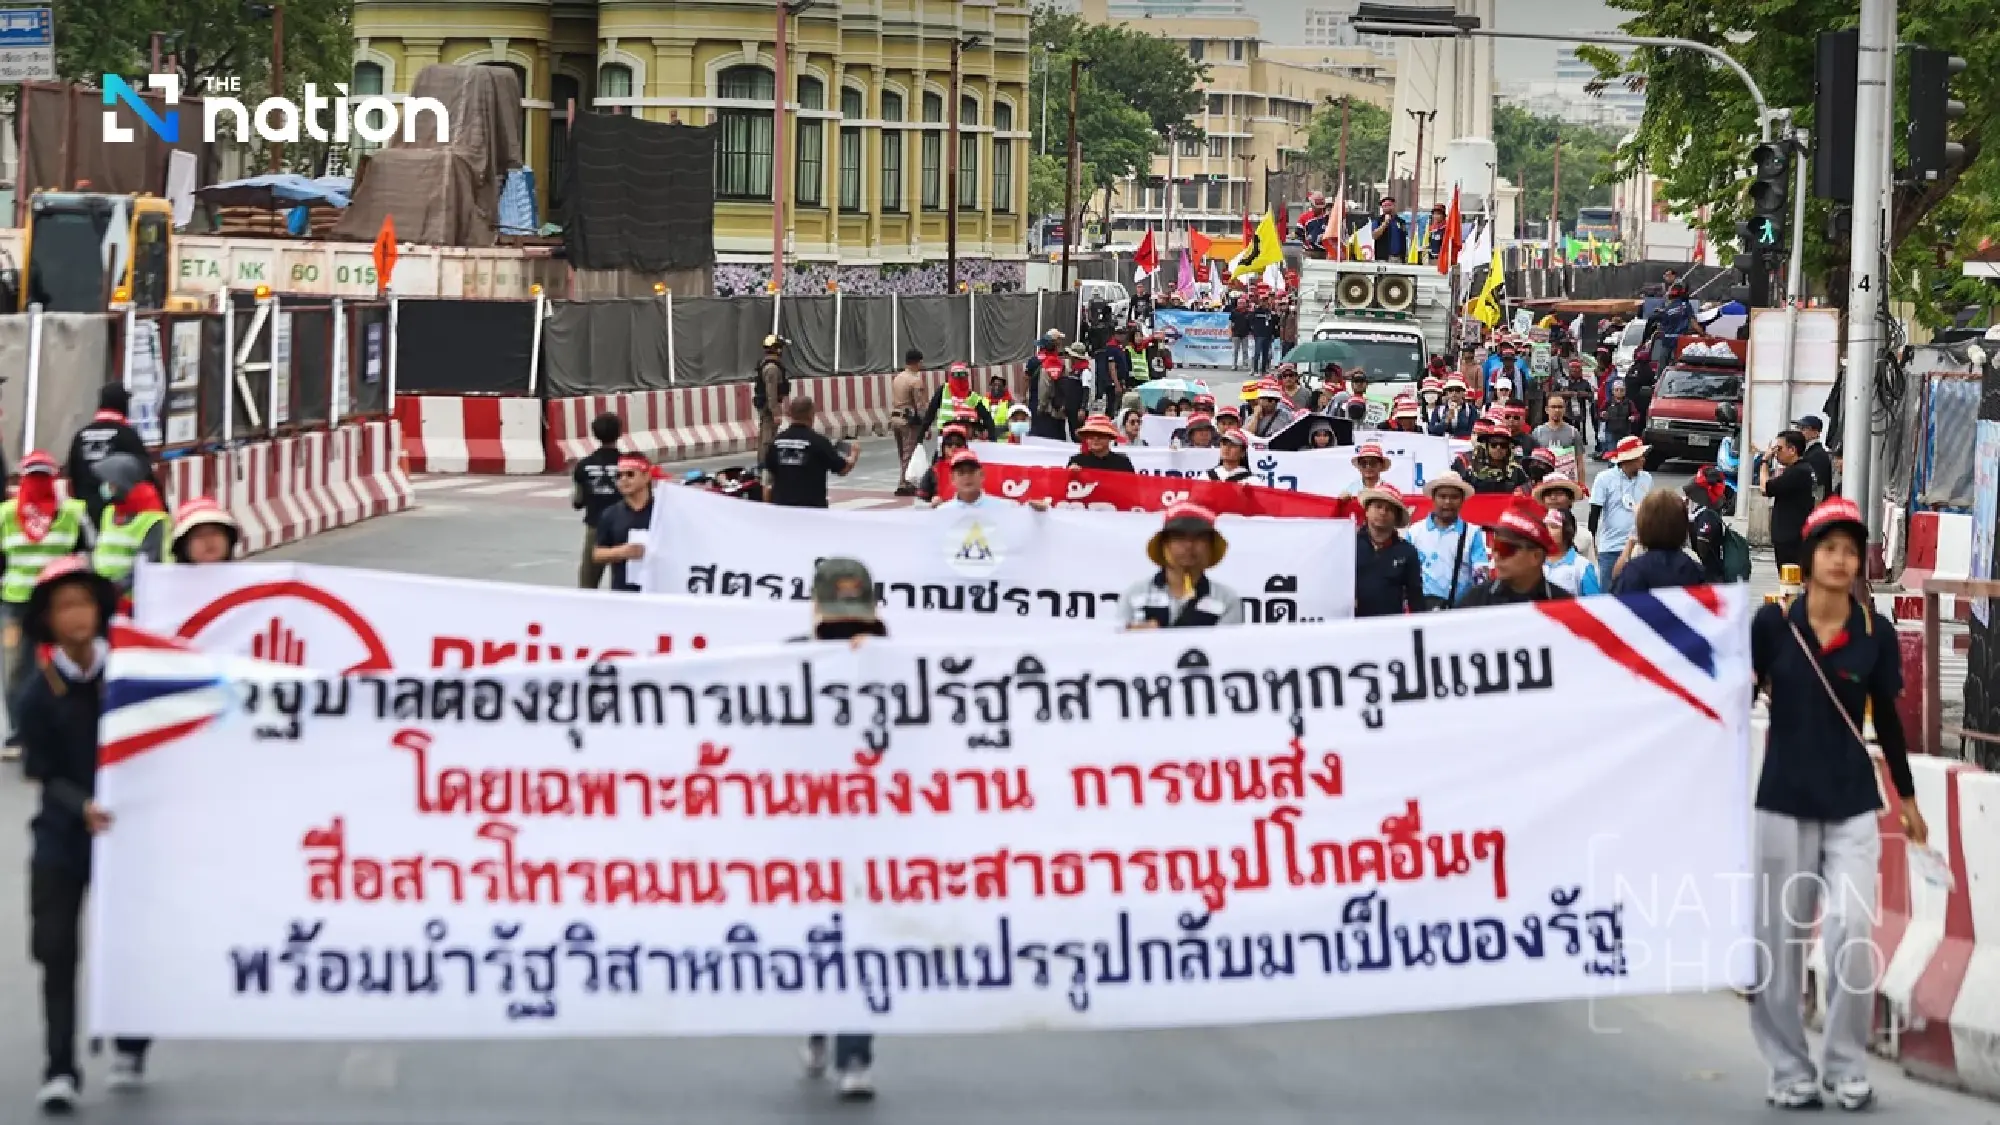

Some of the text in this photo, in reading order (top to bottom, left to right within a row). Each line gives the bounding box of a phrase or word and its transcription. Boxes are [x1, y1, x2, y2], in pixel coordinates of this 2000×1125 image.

[1857, 273, 1872, 293] 4
[391, 728, 1345, 818] โดยเฉพาะด้านพลังงาน การขนส่ง
[302, 799, 1508, 911] สื่อสารโทรคมนาคม และสาธารณูปโภคอื่นๆ
